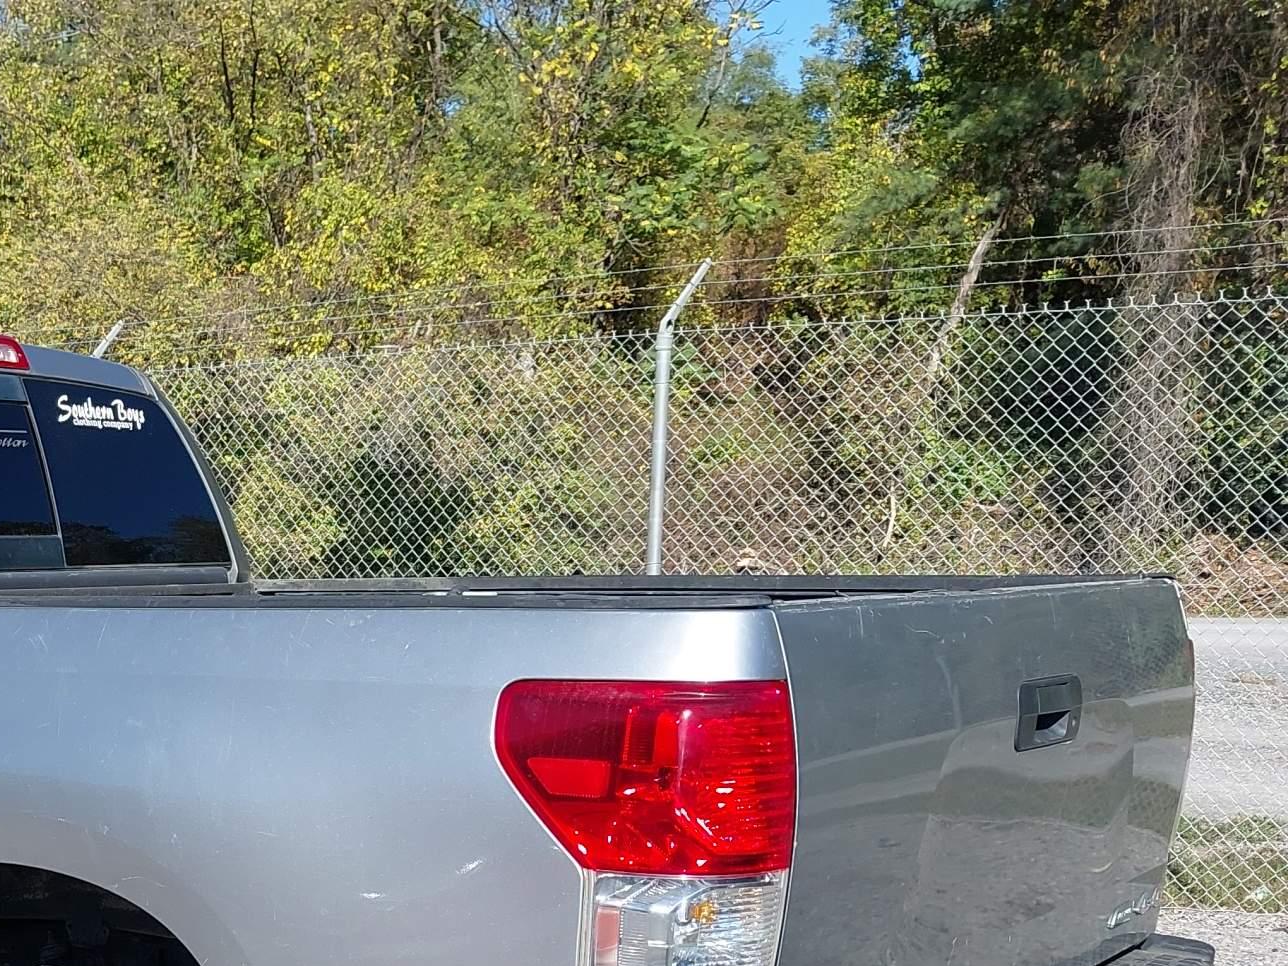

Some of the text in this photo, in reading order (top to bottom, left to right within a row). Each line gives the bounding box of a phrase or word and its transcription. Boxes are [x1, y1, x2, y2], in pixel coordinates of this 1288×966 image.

[57, 394, 145, 430] Southern Boys
[102, 421, 133, 431] company
